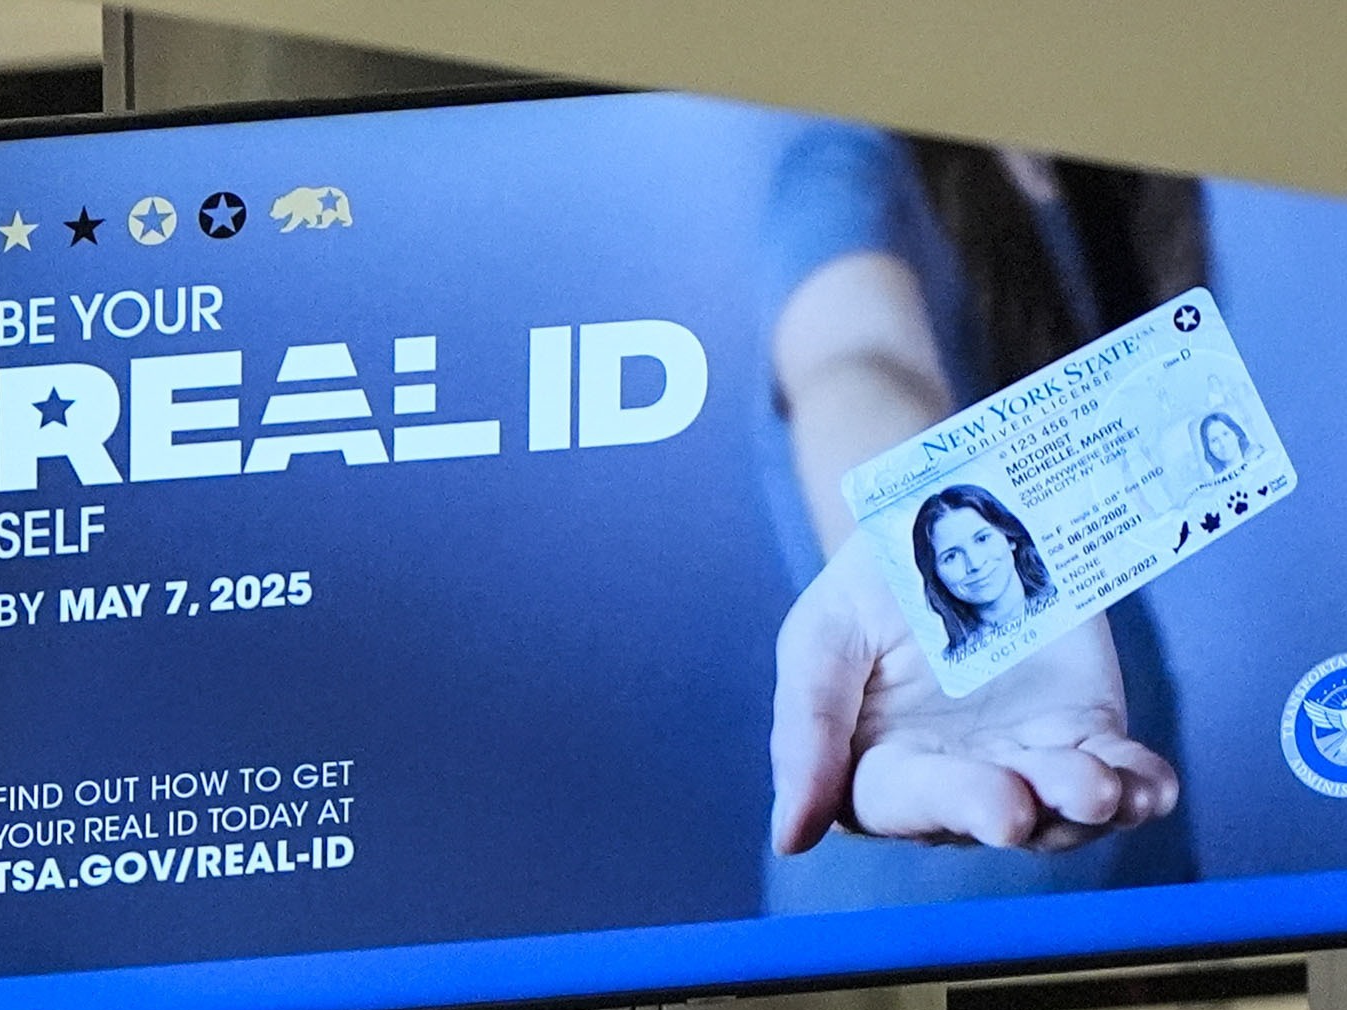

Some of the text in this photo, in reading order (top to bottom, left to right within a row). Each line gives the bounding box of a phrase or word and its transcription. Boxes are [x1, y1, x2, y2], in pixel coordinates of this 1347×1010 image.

[69, 284, 223, 340] YOUR
[528, 318, 709, 452] ID
[921, 415, 985, 461] NEW
[988, 378, 1063, 422] YORK
[1063, 336, 1139, 385] STATE
[966, 370, 1112, 456] DRIVER LICENSE
[1010, 399, 1098, 454] 123 456 789
[1005, 432, 1071, 476] MOTORIST
[1045, 450, 1099, 486] ANYWHERE
[1102, 426, 1140, 453] STREET
[1022, 487, 1053, 509] YOUR
[1068, 558, 1098, 580] NONE
[1075, 569, 1105, 592] NONE
[59, 583, 151, 623] MAY
[165, 581, 200, 617] 7,
[209, 570, 313, 611] 2025
[74, 777, 139, 807] OUT
[151, 770, 231, 801] HOW
[239, 766, 282, 794] TO
[292, 759, 355, 790] GET
[84, 813, 158, 844] REAL
[168, 809, 198, 838] ID
[207, 802, 308, 835] TODAY
[316, 797, 354, 825] AT
